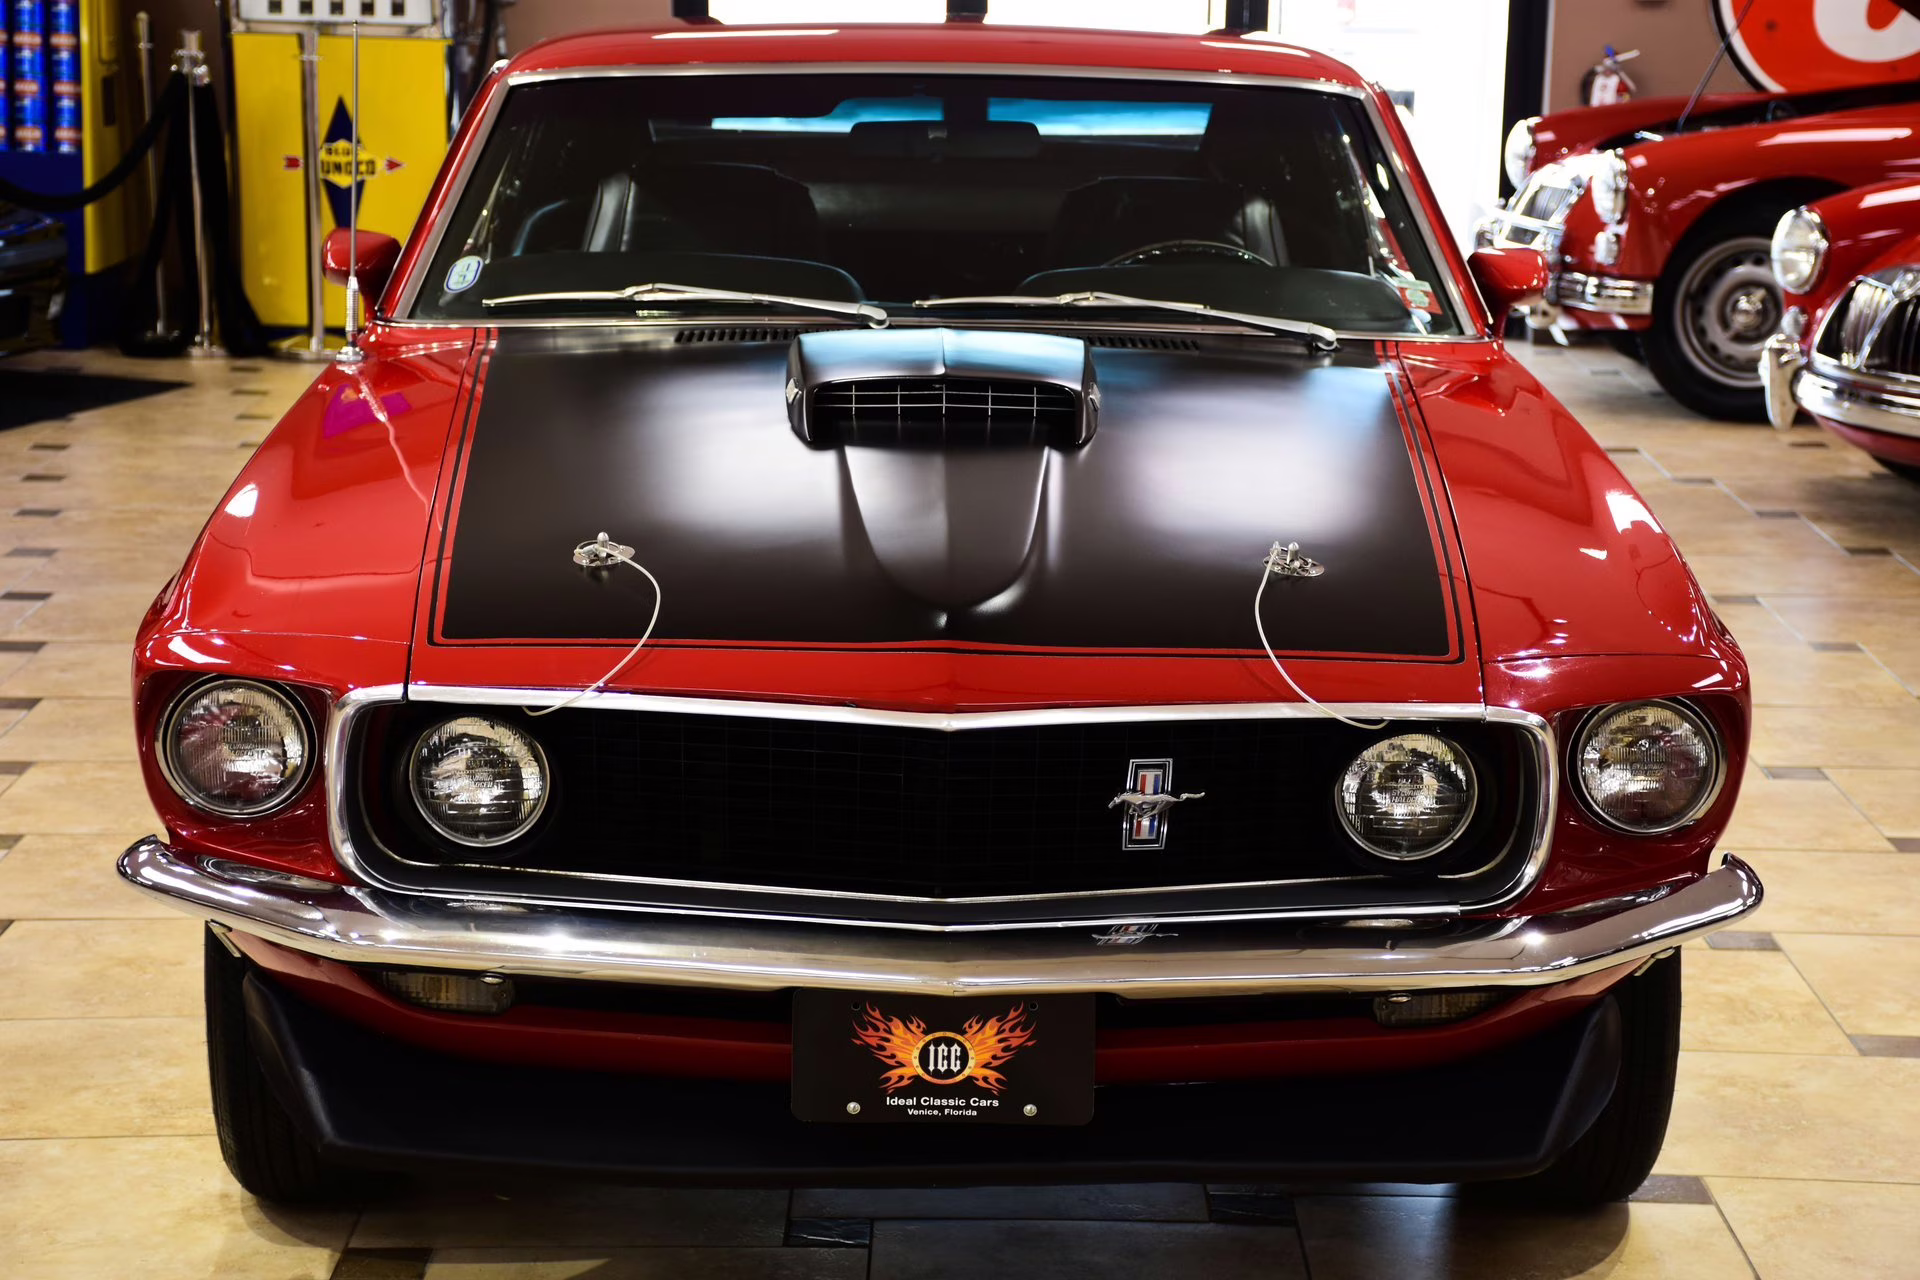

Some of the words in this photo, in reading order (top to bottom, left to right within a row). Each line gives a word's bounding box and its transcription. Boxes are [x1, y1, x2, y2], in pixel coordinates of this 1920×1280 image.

[320, 159, 376, 175] UNOCO
[886, 1096, 917, 1106] Ideal
[920, 1096, 966, 1107] Classic
[969, 1097, 1000, 1107] Cars
[907, 1108, 942, 1116] Venice,
[944, 1108, 978, 1116] Florida
